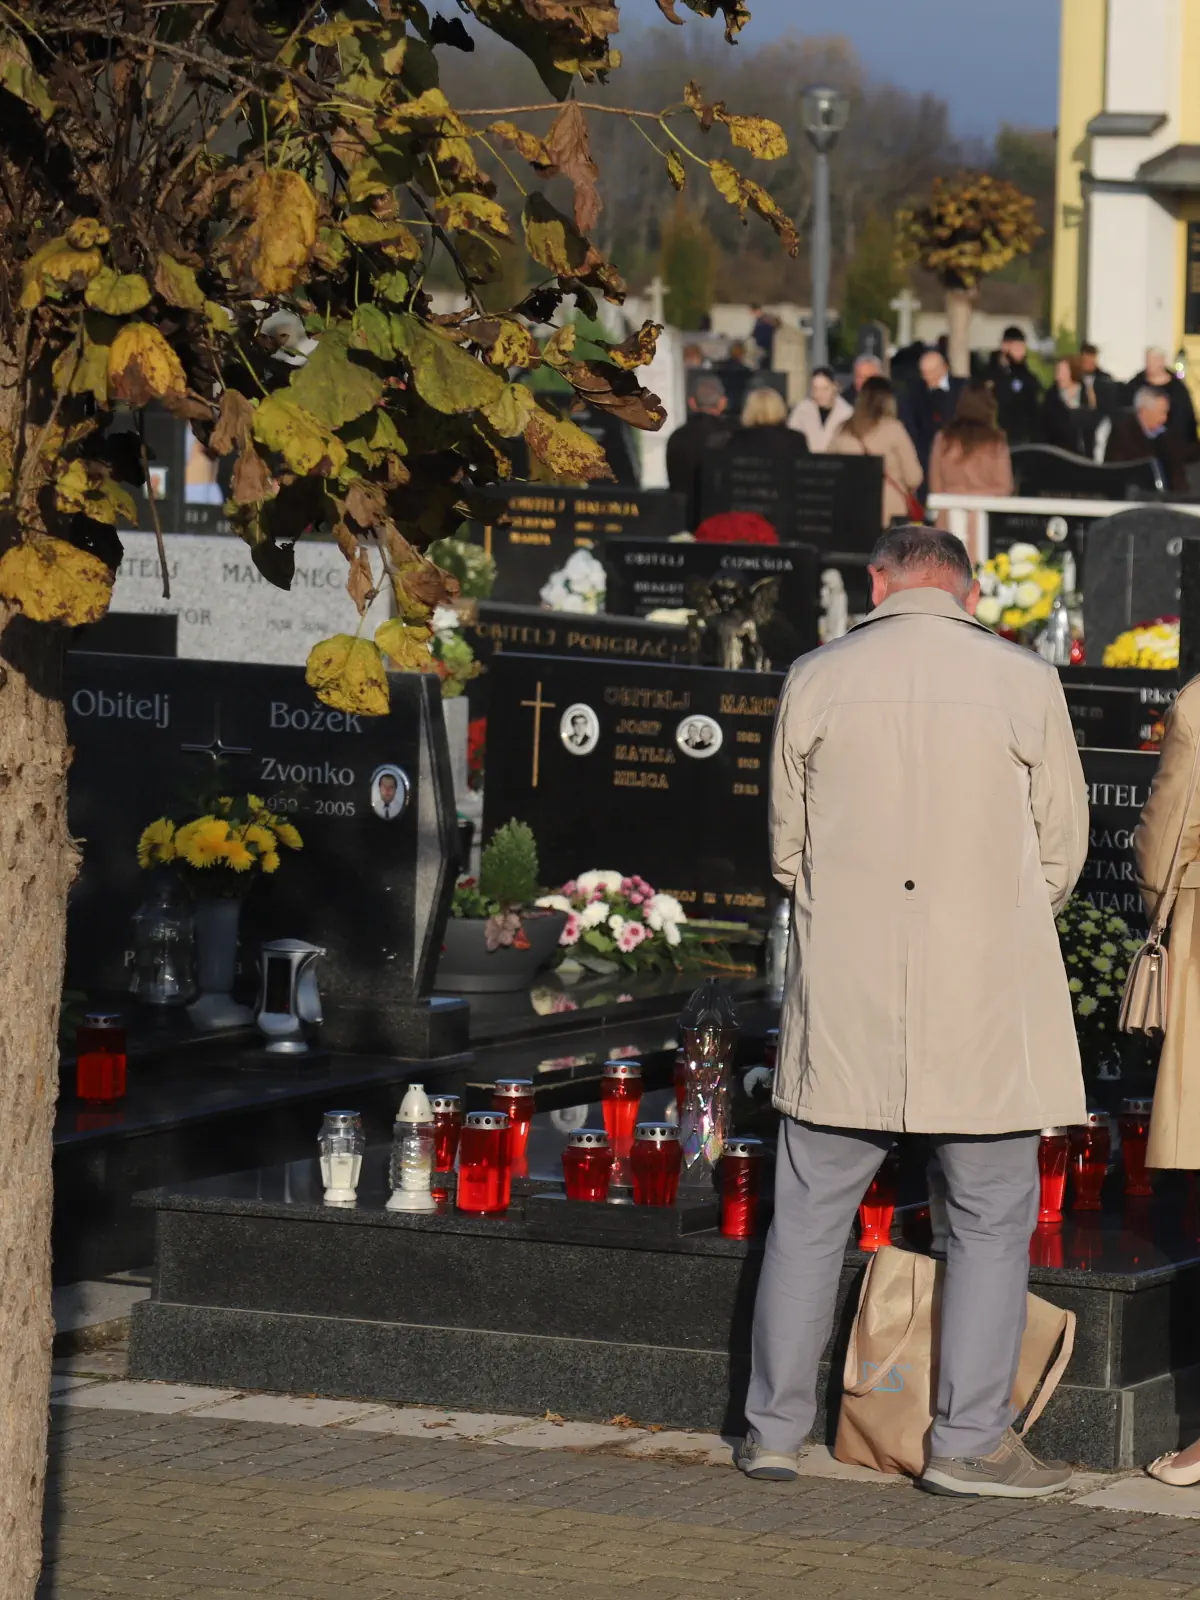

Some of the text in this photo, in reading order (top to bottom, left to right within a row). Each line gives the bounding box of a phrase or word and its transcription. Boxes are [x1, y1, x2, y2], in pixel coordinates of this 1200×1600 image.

[223, 563, 341, 589] MANEC
[72, 689, 364, 734] Obitelj Božek
[260, 757, 356, 786] Zvonko
[315, 800, 356, 817] 2005
[1089, 783, 1152, 808] ITEL
